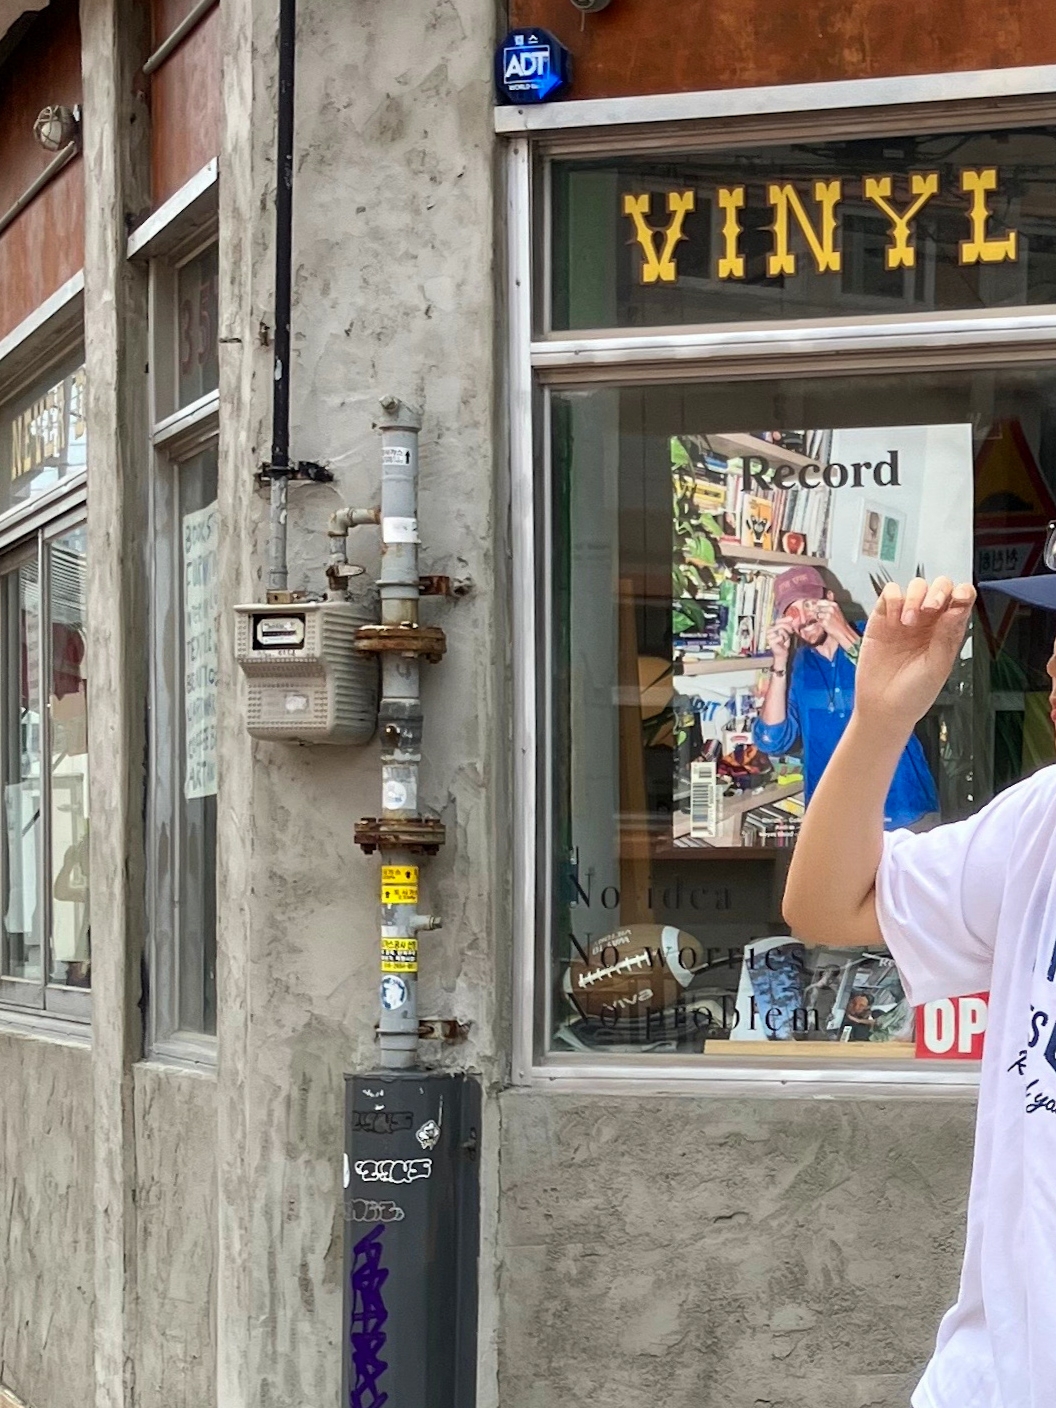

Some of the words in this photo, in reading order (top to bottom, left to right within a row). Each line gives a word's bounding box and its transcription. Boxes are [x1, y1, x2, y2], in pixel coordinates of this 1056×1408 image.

[505, 51, 549, 78] ADT
[623, 167, 1018, 284] VINYL
[741, 450, 901, 492] Record
[569, 871, 620, 910] No
[648, 874, 733, 910] idea
[568, 931, 620, 968] No
[646, 938, 806, 970] worries
[567, 993, 620, 1028] No
[646, 996, 823, 1040] problem
[923, 998, 987, 1054] OP
